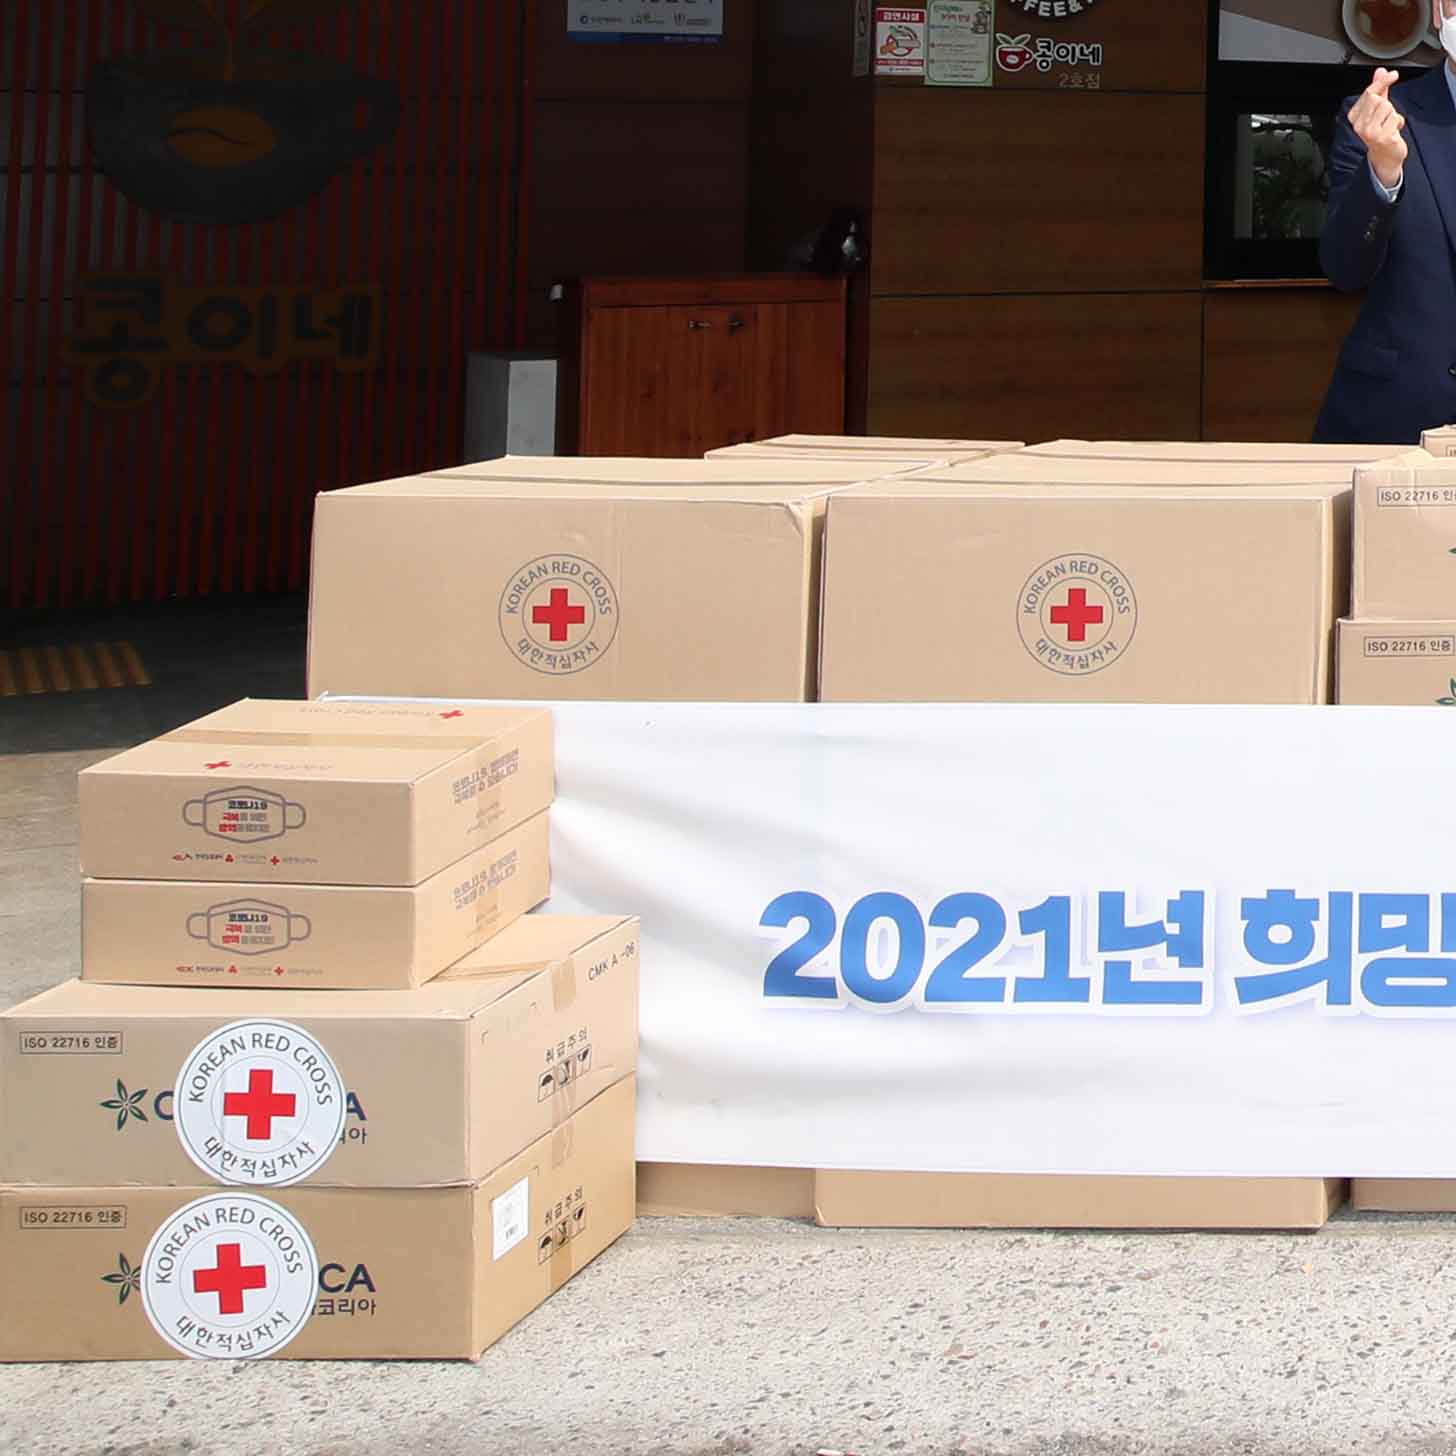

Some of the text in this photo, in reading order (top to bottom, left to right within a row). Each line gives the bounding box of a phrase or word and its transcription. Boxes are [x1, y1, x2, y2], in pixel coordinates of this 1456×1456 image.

[1034, 38, 1102, 72] 콩이네
[1058, 72, 1101, 89] 2호점
[71, 278, 371, 402] 콩이네
[1380, 491, 1402, 503] ISO
[1404, 491, 1440, 503] 22716
[506, 561, 612, 615] KOREAN RED CROSS
[1024, 560, 1130, 615] KOREAN RED CROSS
[518, 638, 599, 670] 대한적십자사
[1035, 638, 1118, 670] 대한적십자사
[1367, 640, 1452, 654] ISO 22716 인증
[760, 888, 1204, 1008] 2021년
[587, 960, 609, 981] CMK
[611, 953, 618, 968] A
[24, 1035, 119, 1050] ISO 22716 인증
[188, 1032, 334, 1108] KOREAN RED CROSS
[203, 1135, 316, 1180] 대한적십자사
[24, 1210, 122, 1226] ISO 22716 인증
[155, 1206, 304, 1285] KOREAN RED CROSS
[175, 1310, 291, 1351] 대한적십자사
